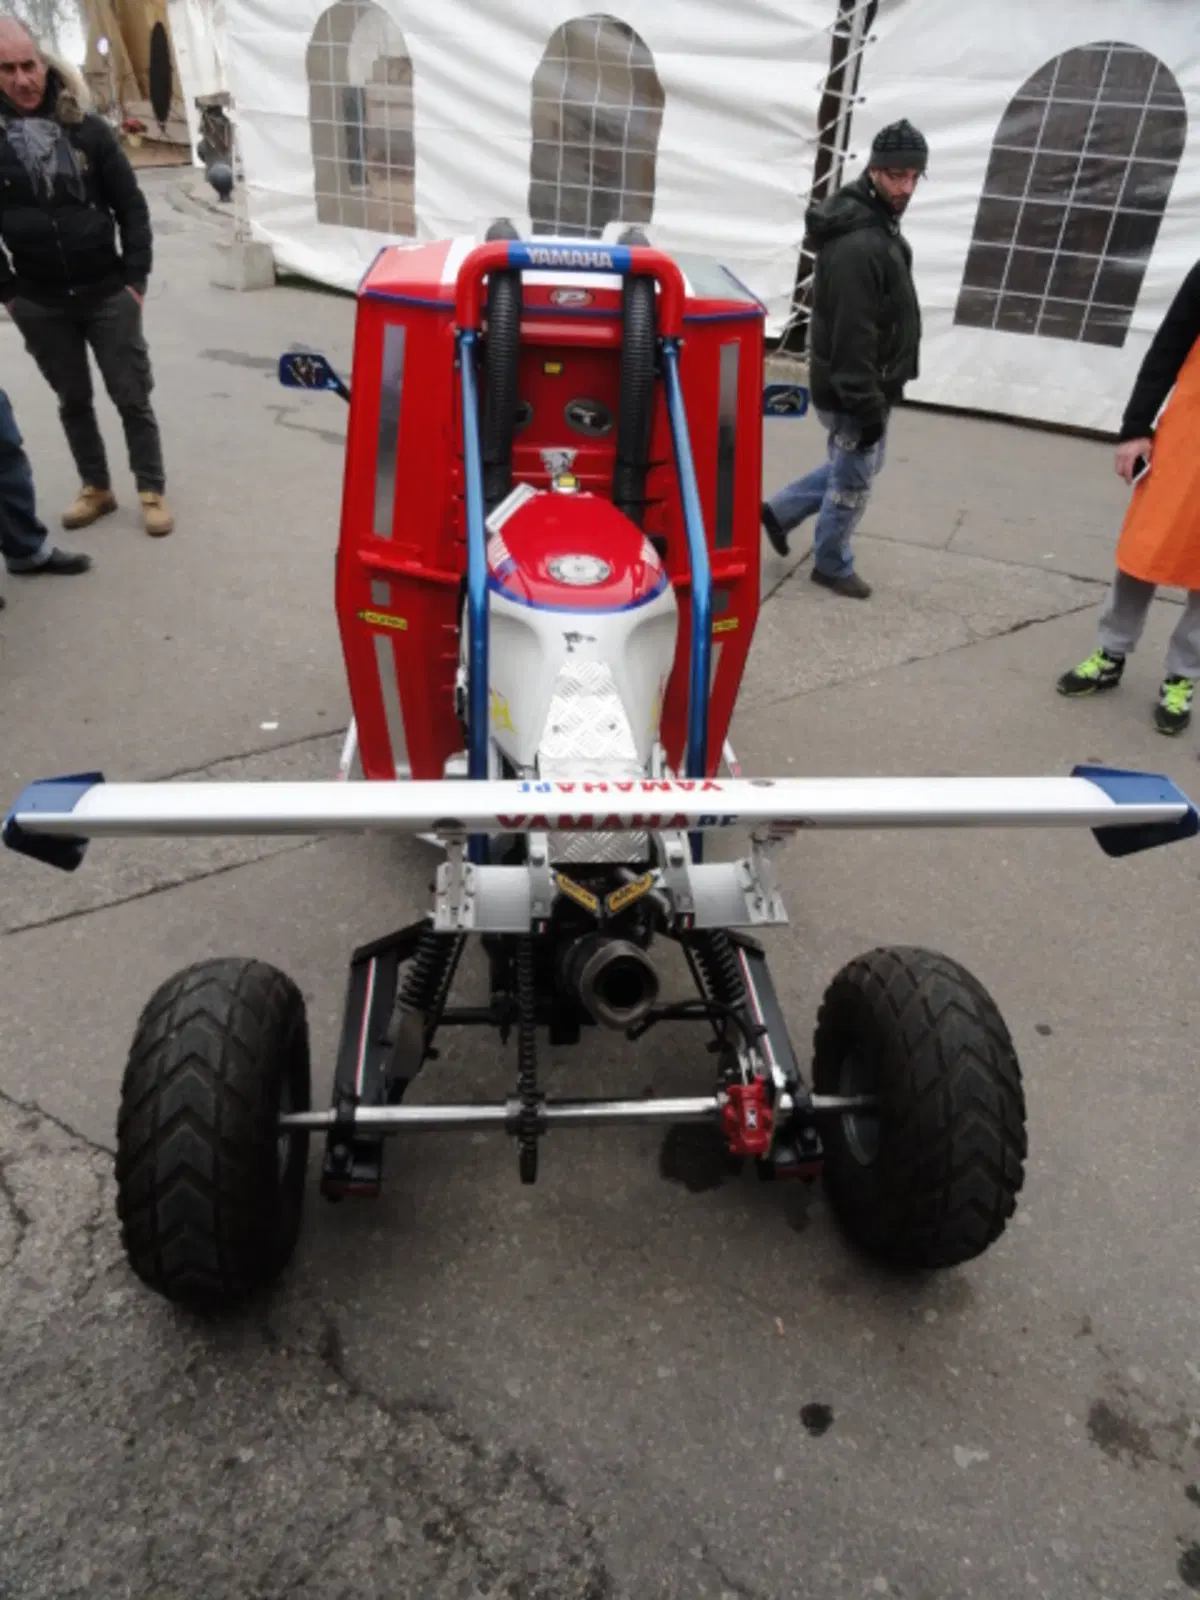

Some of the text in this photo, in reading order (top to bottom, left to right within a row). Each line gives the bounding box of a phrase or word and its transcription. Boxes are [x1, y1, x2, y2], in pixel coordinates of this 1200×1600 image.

[526, 247, 614, 268] YAMAHA
[554, 781, 724, 793] YAMAHA
[494, 813, 691, 830] YAMAHA
